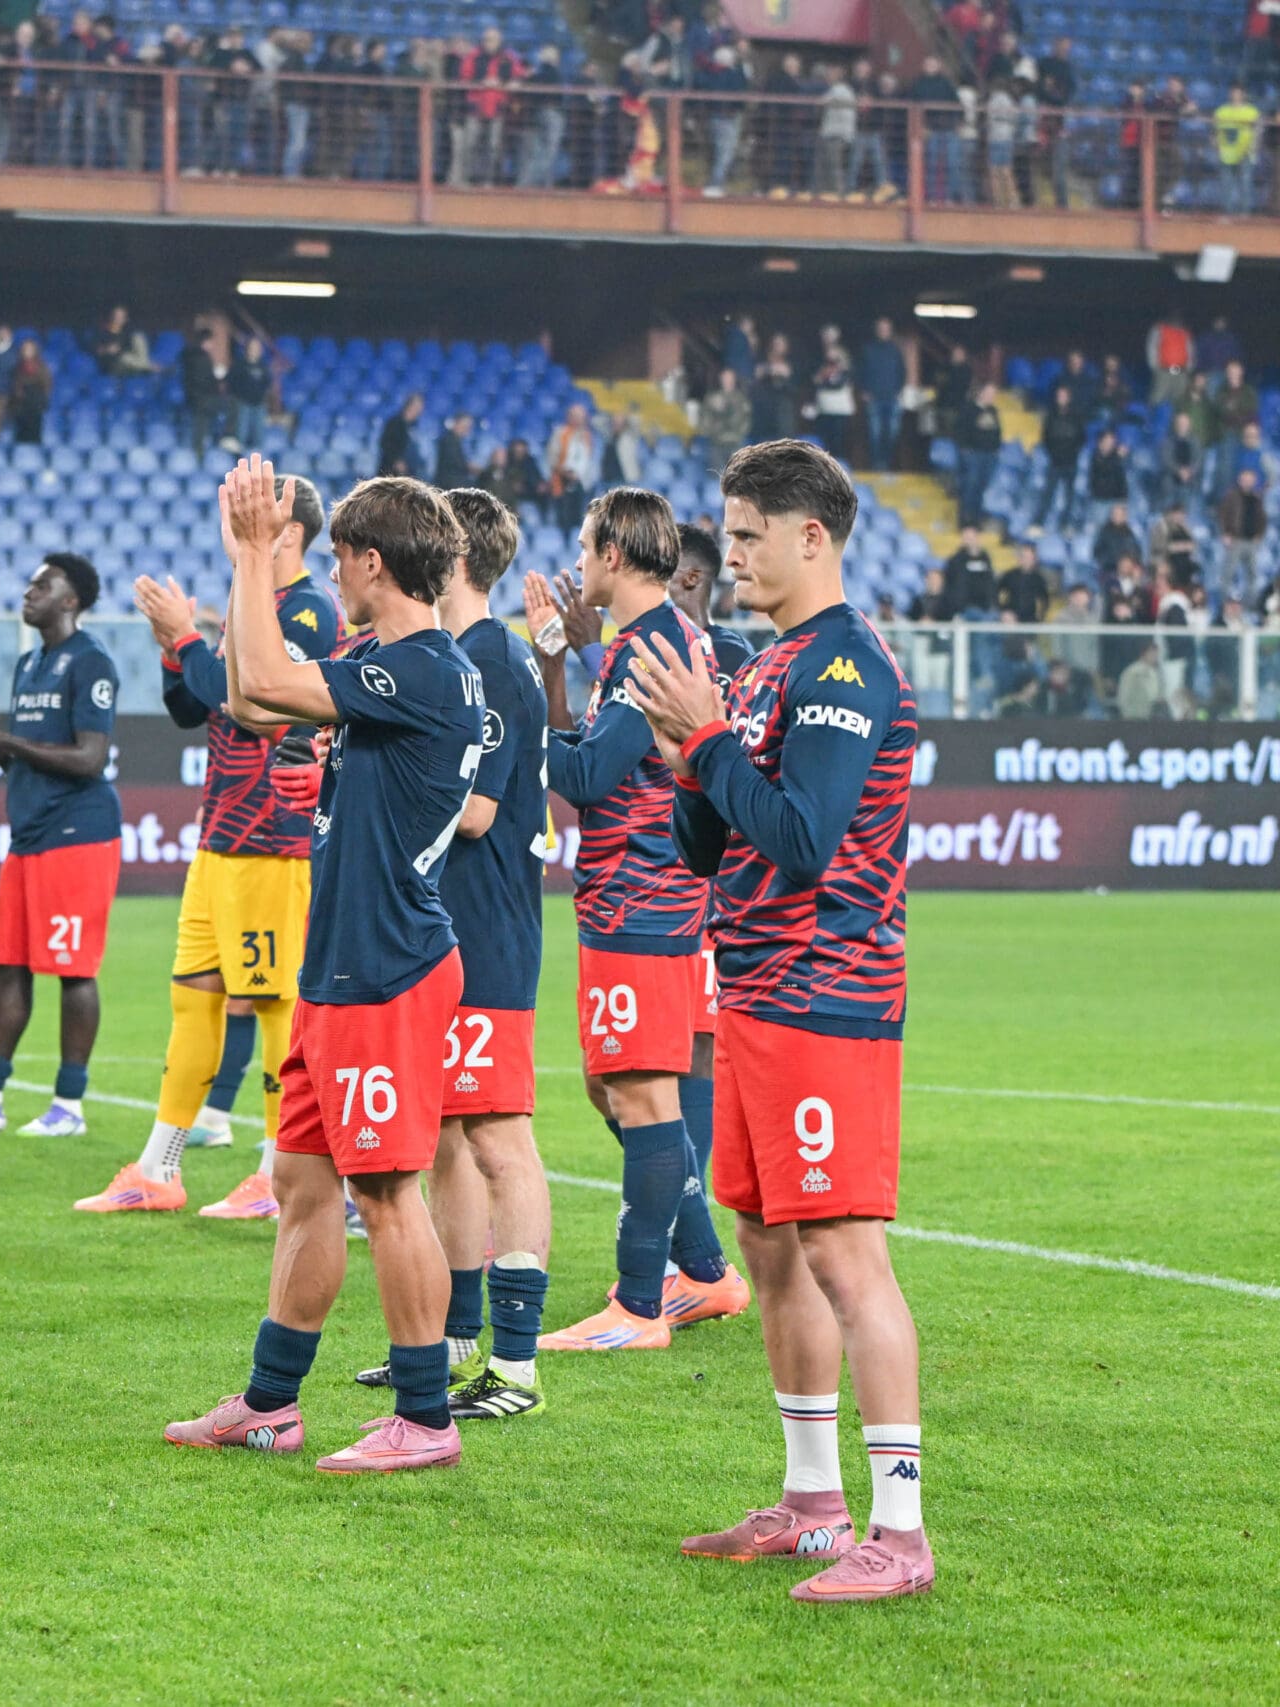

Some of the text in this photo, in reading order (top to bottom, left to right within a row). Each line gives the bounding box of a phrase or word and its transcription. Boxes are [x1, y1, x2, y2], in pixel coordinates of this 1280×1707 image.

[796, 705, 872, 739] HOWDEN
[1130, 810, 1278, 866] infront
[47, 915, 82, 951] 21
[241, 930, 276, 968] 31
[589, 984, 638, 1035] 29
[335, 1065, 398, 1126] 76
[356, 1139, 381, 1150] Kappa
[794, 1096, 835, 1162] 9
[801, 1181, 832, 1194] Kappa
